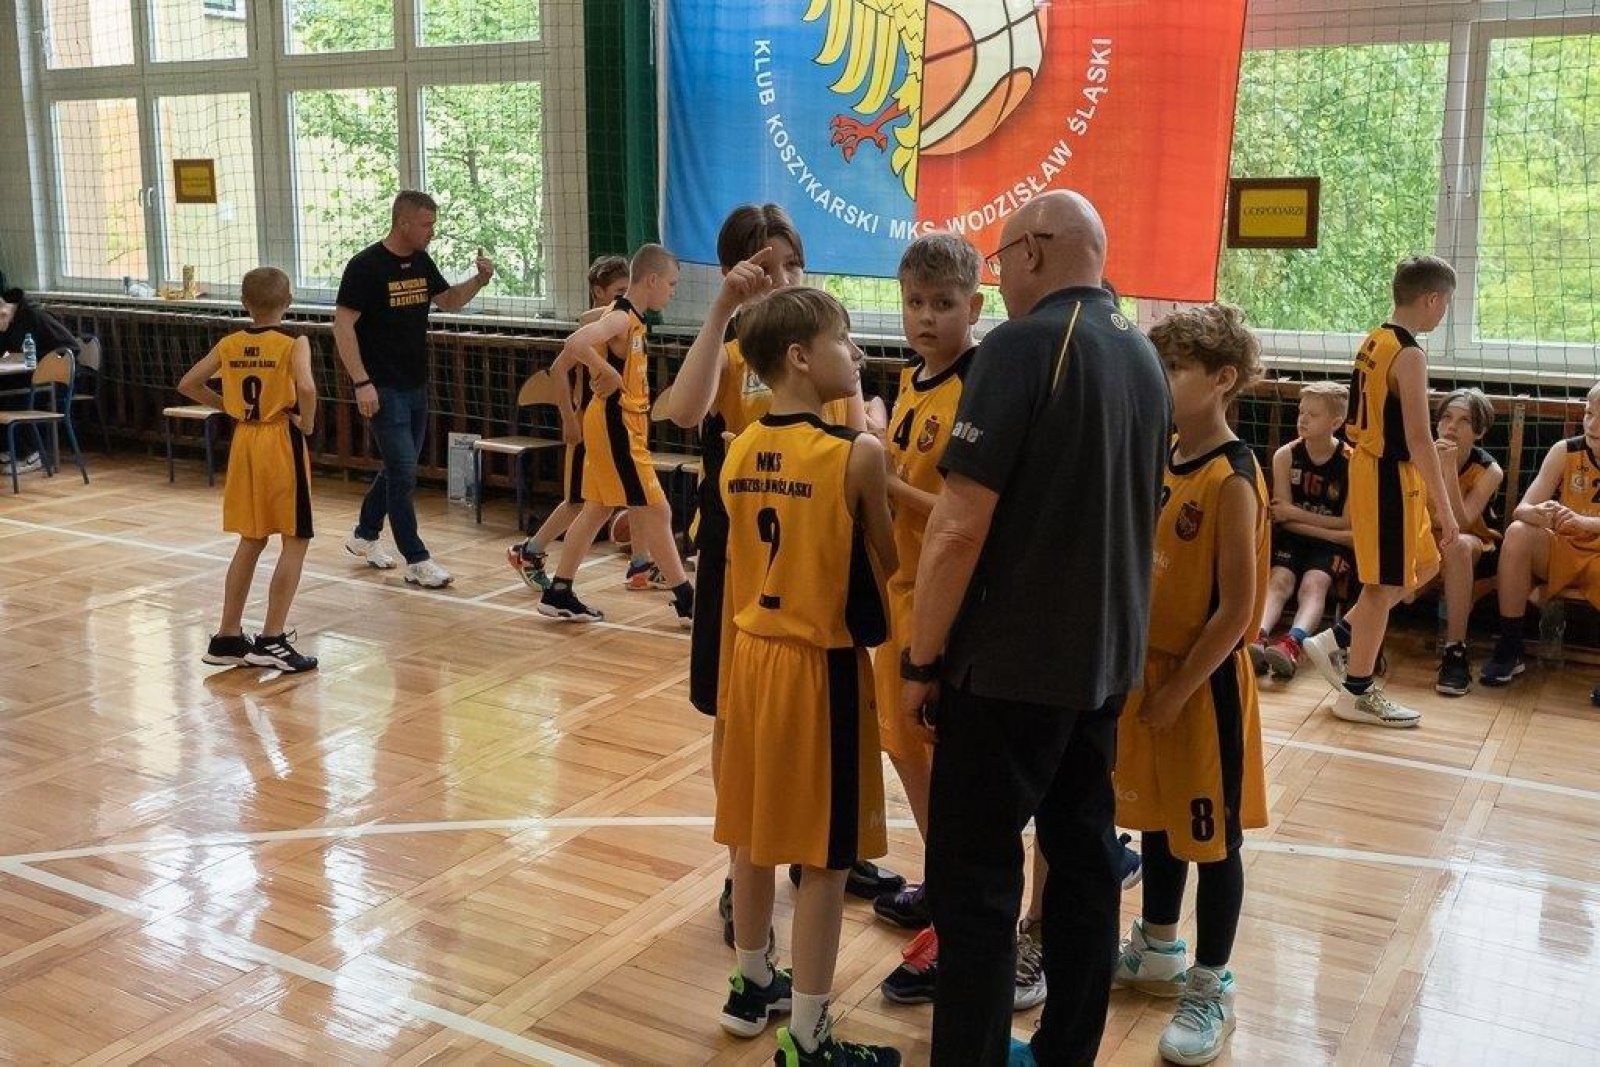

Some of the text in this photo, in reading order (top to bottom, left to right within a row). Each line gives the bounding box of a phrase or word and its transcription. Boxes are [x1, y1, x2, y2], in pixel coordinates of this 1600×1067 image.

[753, 39, 776, 107] KLUB
[766, 113, 879, 235] KOSZYKARSKI
[946, 140, 1074, 237] WODZISŁAW
[1066, 37, 1113, 137] ŚLĄSKI
[892, 408, 915, 451] 4
[756, 451, 782, 472] MKS
[1191, 797, 1215, 842] 8
